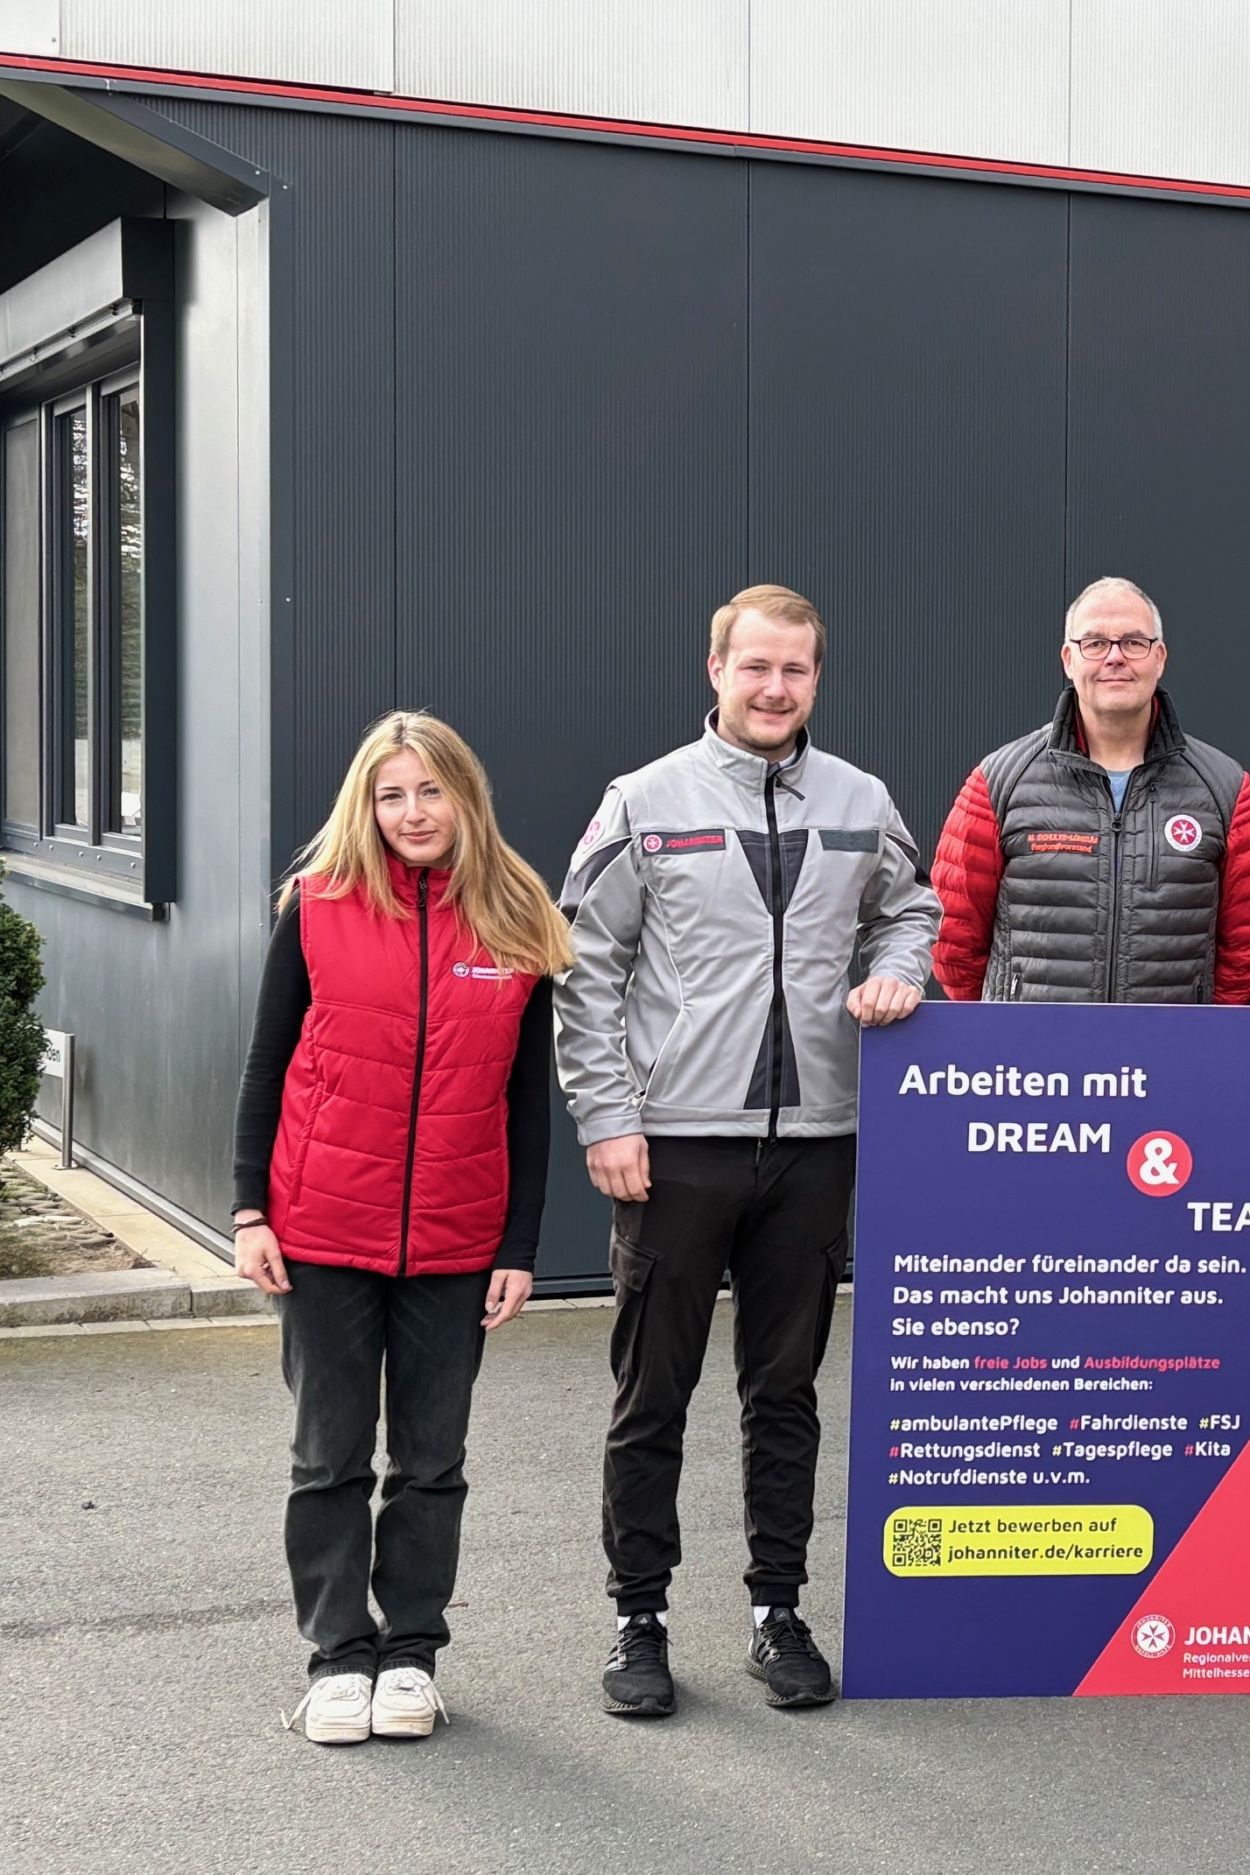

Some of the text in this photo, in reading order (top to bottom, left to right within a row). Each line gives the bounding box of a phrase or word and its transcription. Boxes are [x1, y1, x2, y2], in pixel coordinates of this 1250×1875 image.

[898, 1064, 1147, 1098] Arbeiten mit
[967, 1122, 1111, 1153] DREAM
[1139, 1138, 1180, 1185] &
[894, 1253, 1247, 1274] Miteinander füreinander da sein.
[893, 1285, 1224, 1305] Das macht uns Johanniter aus.
[892, 1317, 1020, 1336] Sie ebenso?
[890, 1355, 1221, 1373] Wir haben freie Jobs und Ausbildungsplätze
[890, 1376, 1153, 1392] in vielen verschiedenen Bereichen:
[889, 1413, 1241, 1435] #ambulantePflege #Fahrdienste #FSJ
[889, 1440, 1232, 1462] #Rettungsdienst #Tagespflege #Kita
[888, 1468, 1090, 1485] #Notrufdienste u.v.m.
[948, 1517, 1117, 1533] Jetzt bewerben auf
[947, 1544, 1143, 1563] johanniter.de/karriere
